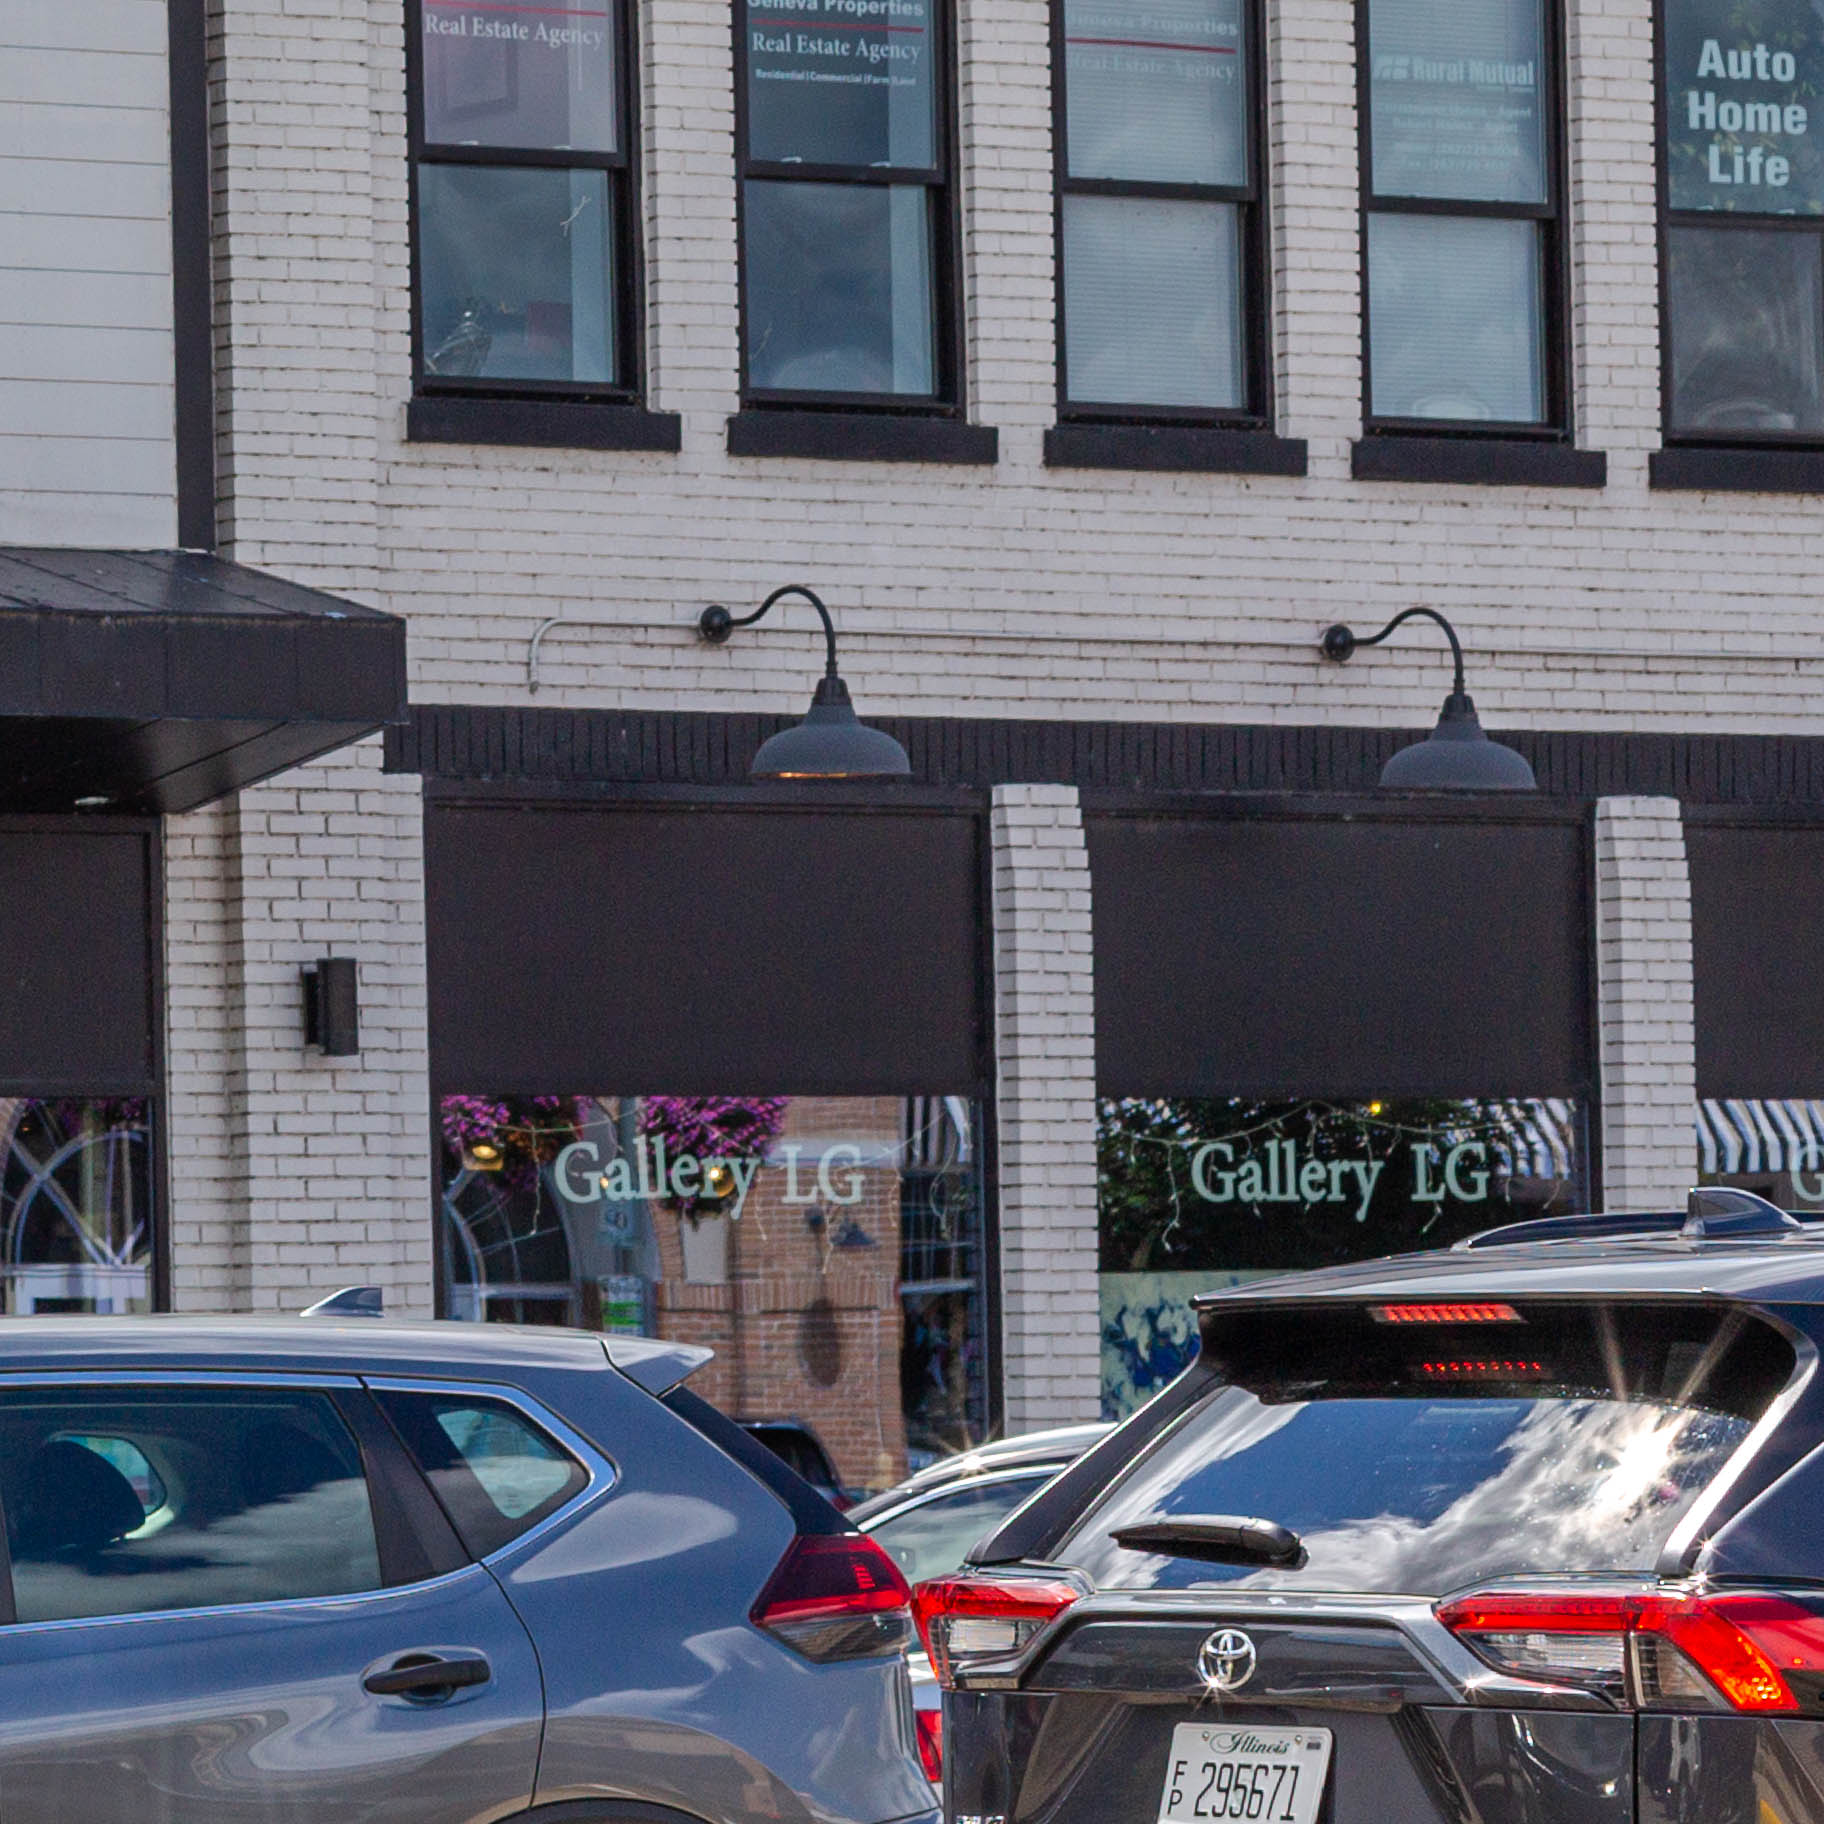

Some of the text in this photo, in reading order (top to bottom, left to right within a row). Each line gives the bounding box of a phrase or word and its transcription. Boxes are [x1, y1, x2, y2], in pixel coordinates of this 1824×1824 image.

[425, 14, 604, 52] Real Estate Agency
[753, 33, 920, 64] Real Estate Agency
[1469, 59, 1534, 86] Mutual
[1697, 38, 1795, 82] Auto
[1687, 90, 1808, 136] Home
[1708, 145, 1790, 187] Life
[555, 1133, 864, 1220] Gallery LG
[1191, 1139, 1490, 1223] Gallery LG
[1210, 1731, 1290, 1754] Illinois
[1194, 1762, 1300, 1821] 295671
